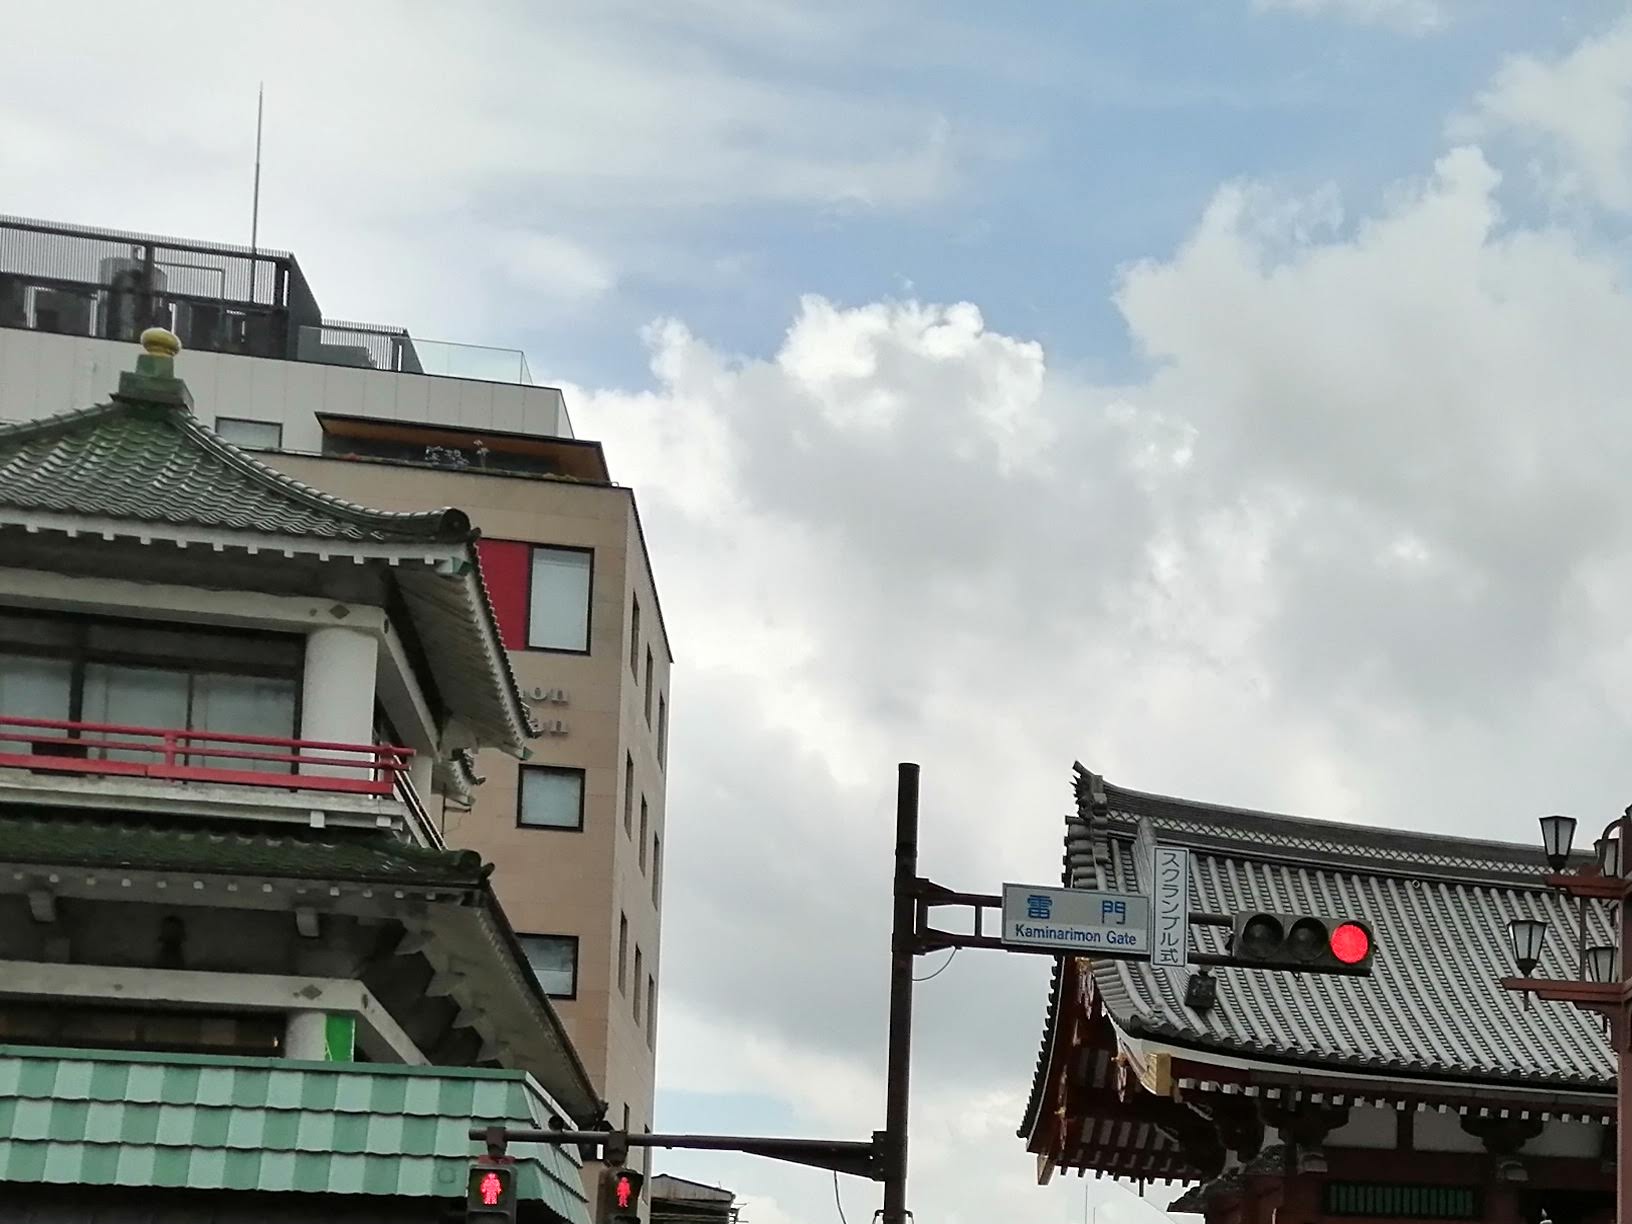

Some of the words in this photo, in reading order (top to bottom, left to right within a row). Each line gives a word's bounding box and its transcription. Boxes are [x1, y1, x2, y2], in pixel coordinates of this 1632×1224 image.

[1026, 893, 1127, 926] 雷門
[1159, 851, 1181, 965] スクランブル式
[1015, 923, 1102, 943] Kaminarimon
[1106, 930, 1138, 947] Gate
